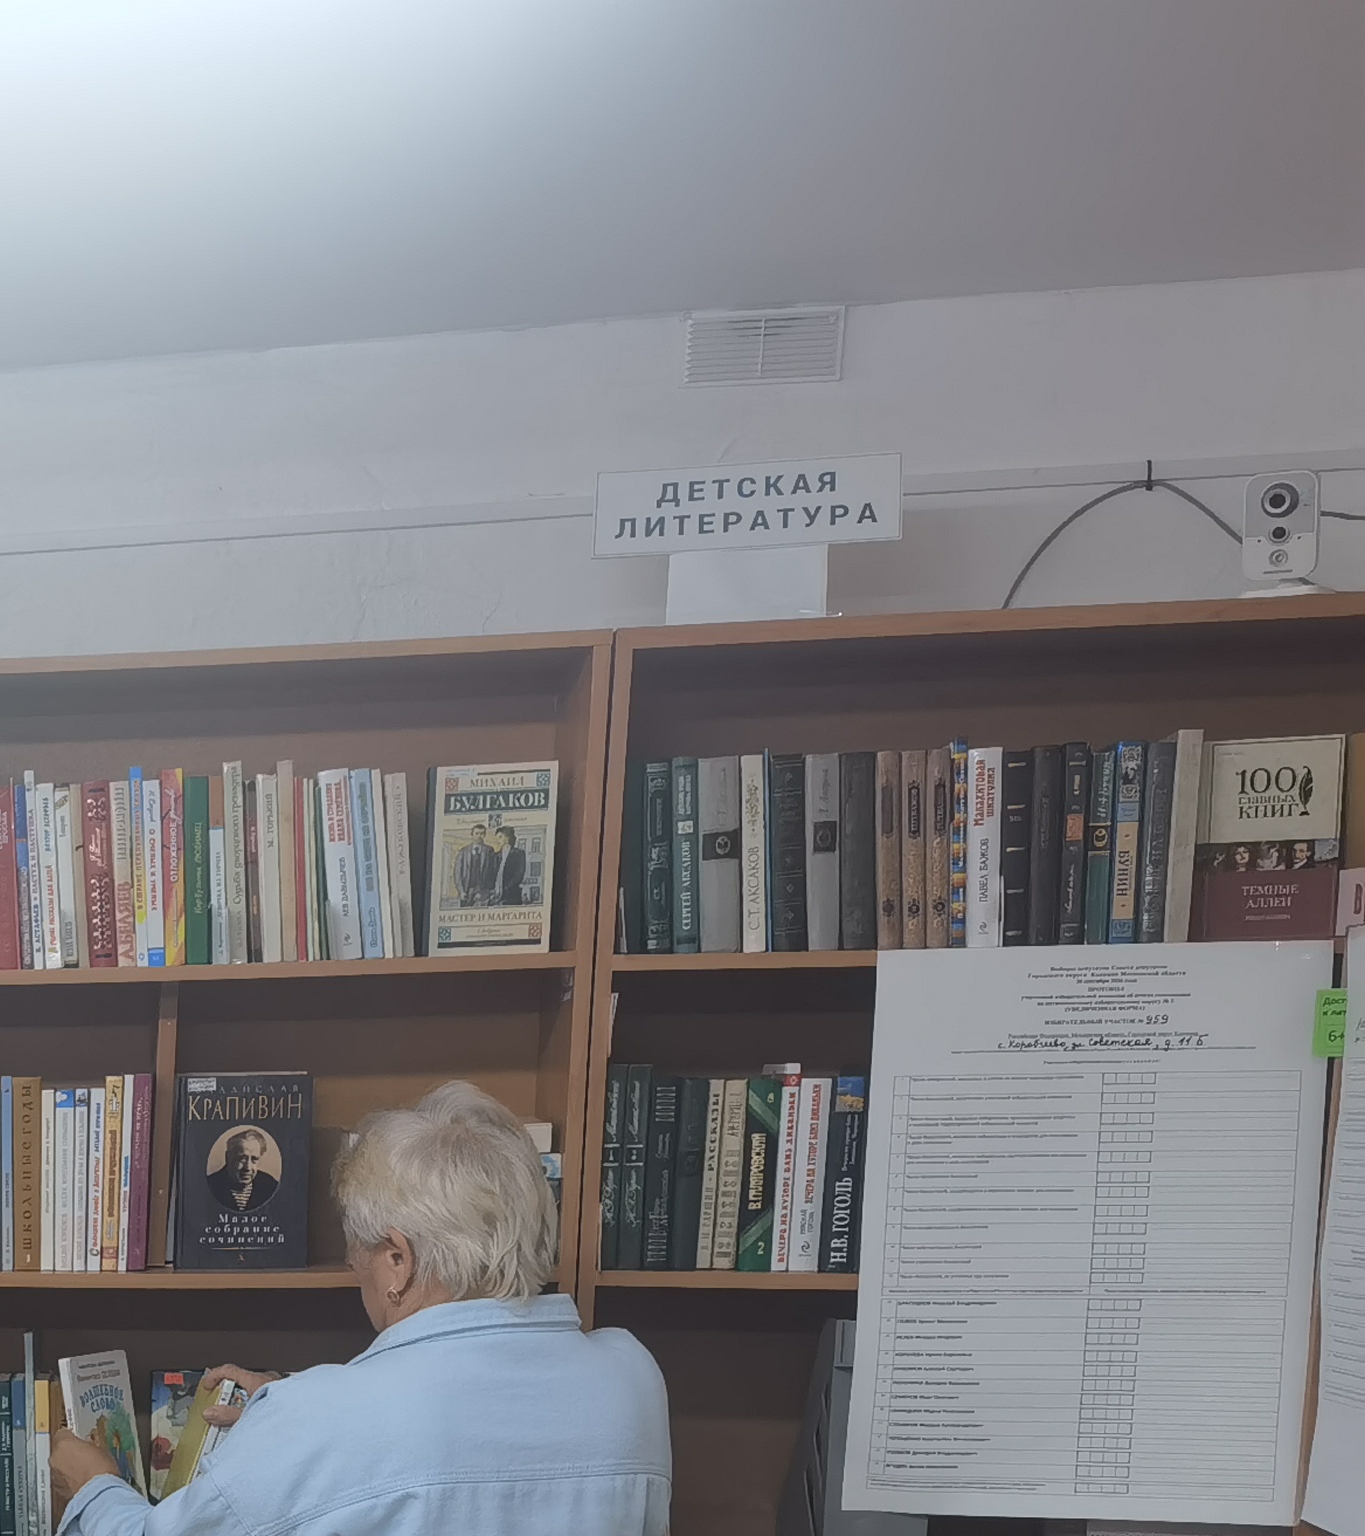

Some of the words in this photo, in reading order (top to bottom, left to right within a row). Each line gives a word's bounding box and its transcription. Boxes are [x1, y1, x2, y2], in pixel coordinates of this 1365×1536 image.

[656, 471, 837, 508] ДЕТСКАЯ
[615, 503, 878, 539] ЛИТЕРАТУРА
[470, 776, 524, 788] МИХАИЛ
[973, 759, 986, 826] Малахитовая
[1235, 766, 1297, 795] 100
[450, 792, 546, 811] БУЛГАКОВ
[1238, 795, 1297, 805] ГЛАВНЫХ
[1238, 804, 1299, 819] КНИГ
[27, 809, 36, 852] ПАСТУШКА
[169, 822, 179, 882] ОТЛОЖЕННОЕ
[979, 838, 989, 871] БАЖОВ
[747, 846, 760, 905] АКСАКОВ
[1116, 850, 1130, 896] БУНИН
[979, 874, 989, 902] ПАВЕЛ
[1241, 884, 1299, 896] ТЕМНЫЕ
[439, 912, 476, 922] МАСТЕР
[478, 913, 485, 921] И
[487, 911, 542, 921] МАРГАРИТА
[1245, 897, 1292, 909] АЛЛЕИ
[748, 908, 760, 930] С.Т.
[188, 1093, 302, 1121] КРАПИВИН
[708, 1093, 720, 1171] РАССКАЗЫ
[832, 1177, 852, 1231] ГОГОЛЬ
[205, 1225, 280, 1235] собрание
[219, 1214, 268, 1223] Малое
[781, 1213, 788, 1226] НА
[199, 1234, 285, 1244] сочинений
[777, 1228, 786, 1263] ВЕЧЕРА
[830, 1235, 848, 1263] Н.В.
